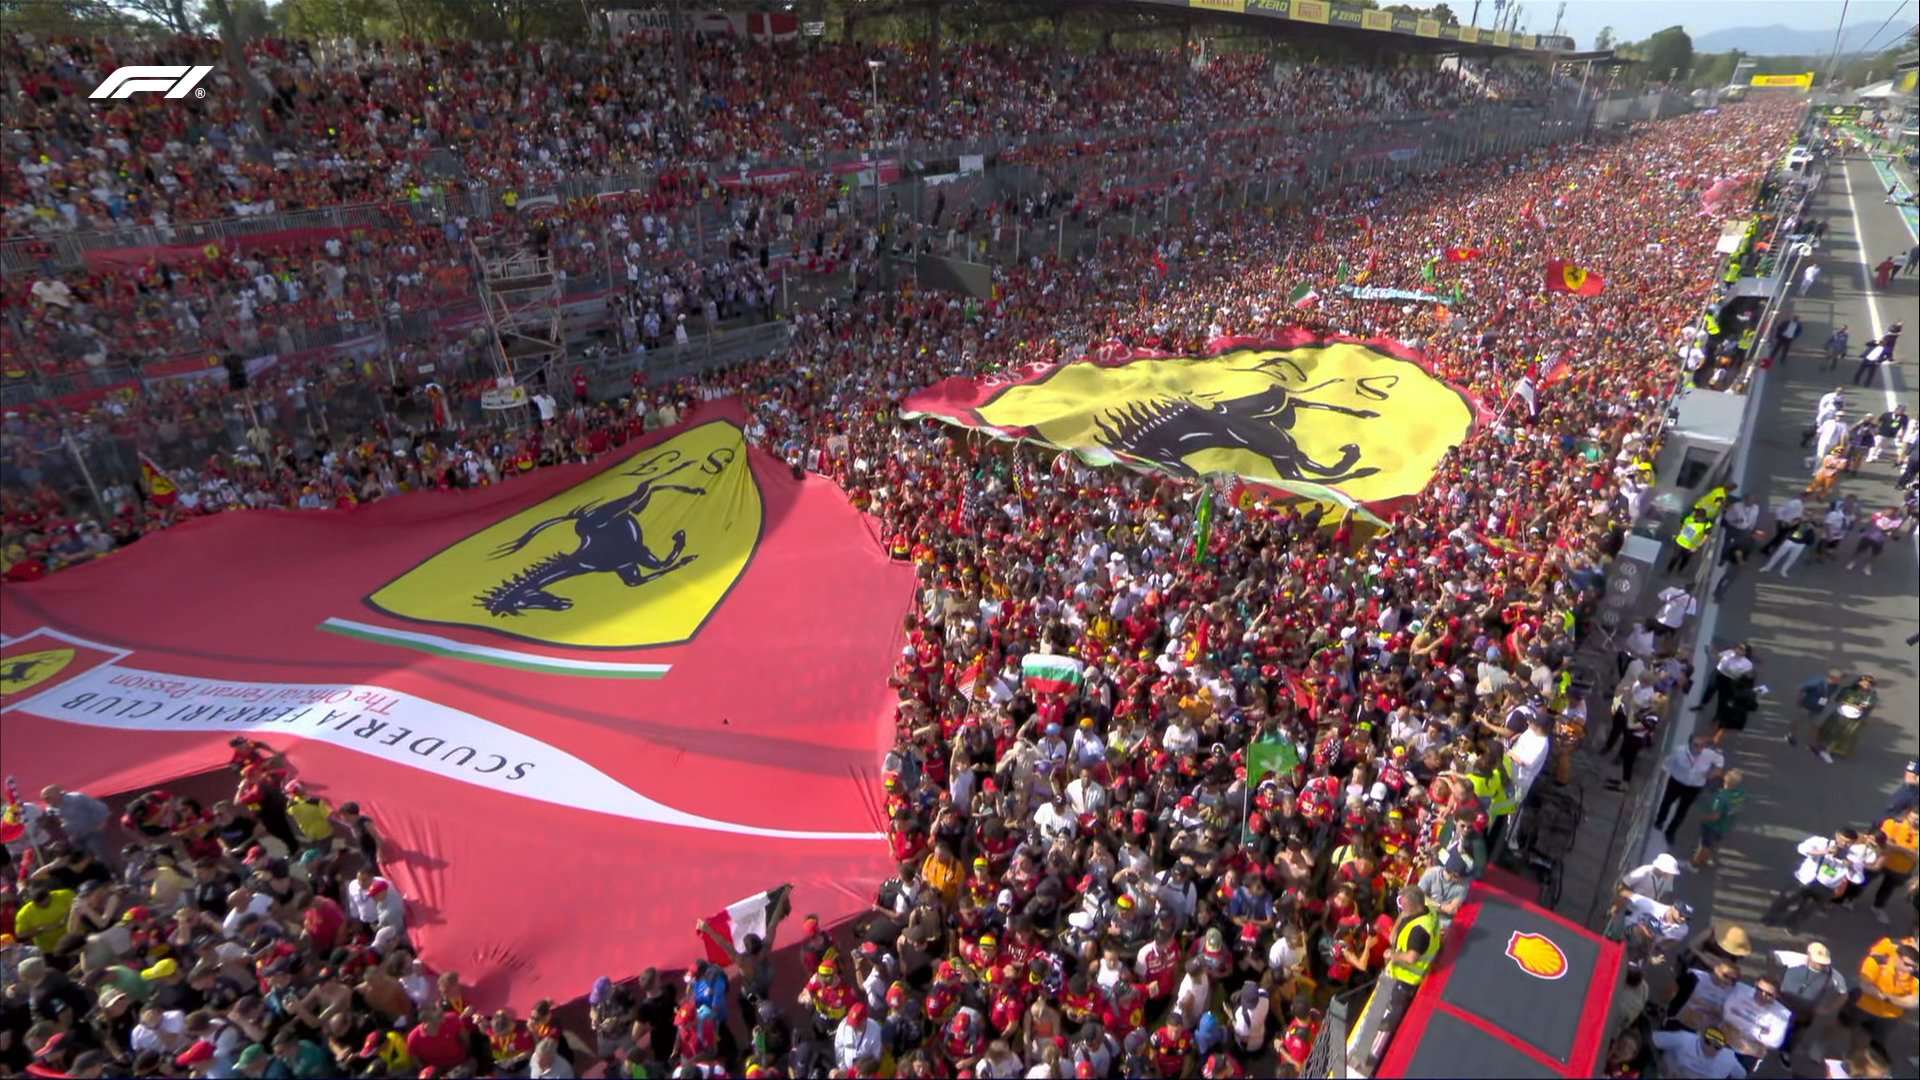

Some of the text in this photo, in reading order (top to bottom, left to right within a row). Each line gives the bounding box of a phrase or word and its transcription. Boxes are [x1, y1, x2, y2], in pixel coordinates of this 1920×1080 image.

[627, 13, 695, 29] CHARES
[109, 673, 199, 699] Passion
[354, 690, 400, 716] The
[61, 692, 536, 781] SCUDERIA FERRARI CLUB
